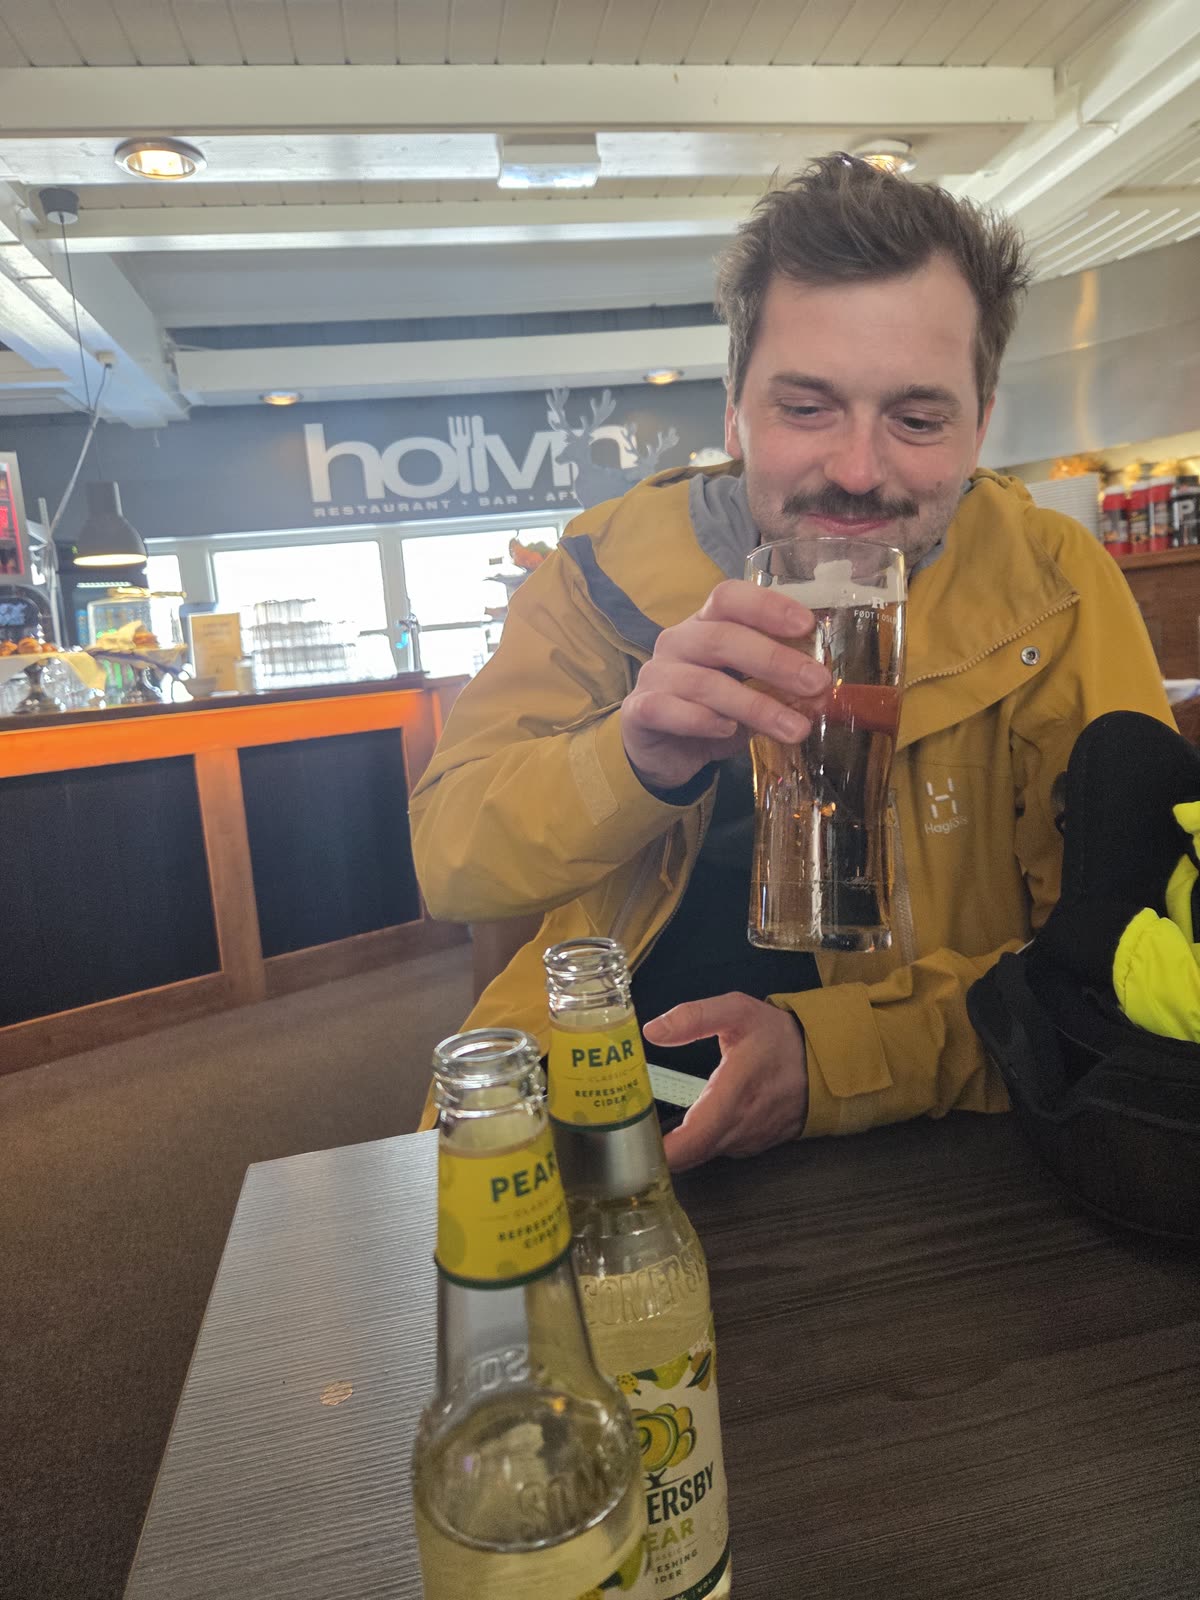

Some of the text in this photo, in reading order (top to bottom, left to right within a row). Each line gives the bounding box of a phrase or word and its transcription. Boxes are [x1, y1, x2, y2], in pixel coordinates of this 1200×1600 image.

[313, 500, 450, 517] RESTAURANT
[479, 494, 518, 507] BAR
[854, 609, 875, 620] FØDT
[571, 1039, 635, 1068] PEAR
[575, 1078, 639, 1098] REFRESHING
[593, 1094, 627, 1108] CIDER
